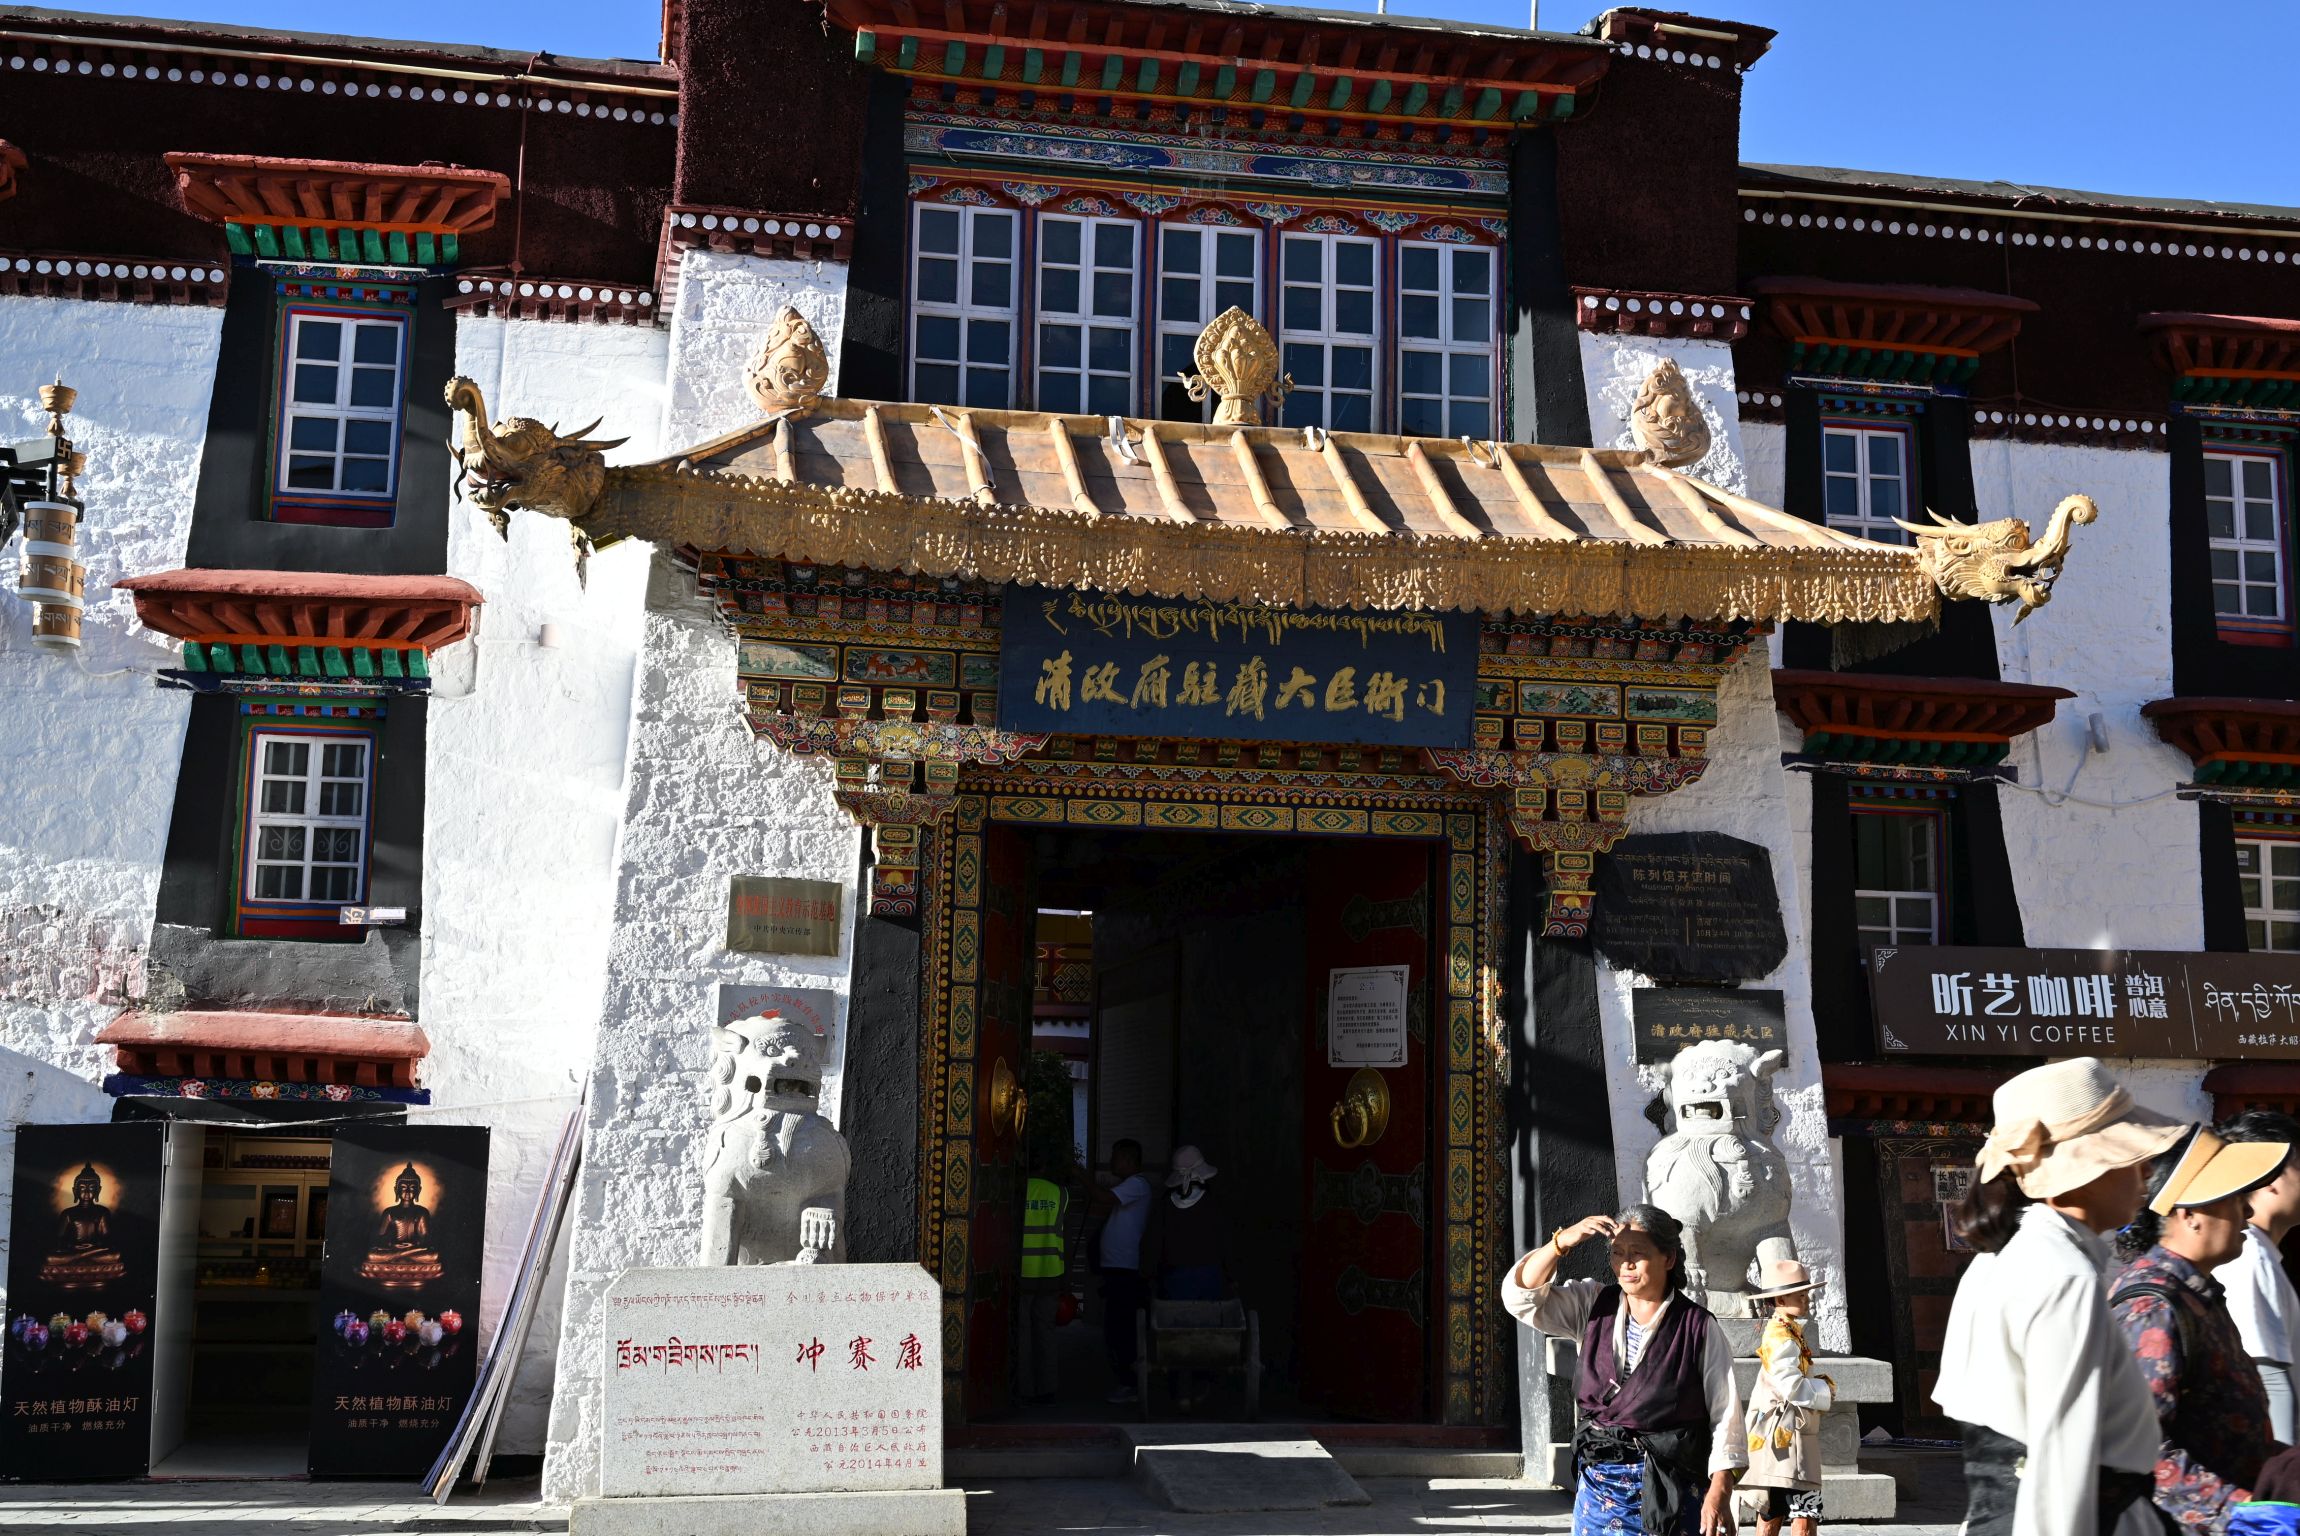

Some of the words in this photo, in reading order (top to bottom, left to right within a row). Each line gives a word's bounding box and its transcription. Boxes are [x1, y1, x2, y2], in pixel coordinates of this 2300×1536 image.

[1632, 868, 1732, 885] 陈列馆开馆时间
[753, 924, 811, 936] 中共中央宣传部
[2124, 973, 2165, 997] 普洱
[1931, 972, 2118, 1019] 昕艺咖啡
[2128, 996, 2169, 1019] 心意
[1946, 1024, 1986, 1041] XIN
[1996, 1025, 2018, 1042] YI
[2029, 1025, 2117, 1043] COFFEE
[2238, 1033, 2300, 1047] 西藏拉萨大昭
[786, 1289, 930, 1304] 全国重点文物保护单位
[796, 1333, 924, 1374] 冲赛康
[13, 1396, 140, 1417] 天然植物酥油灯
[334, 1395, 453, 1412] 天然植物酥油灯
[796, 1408, 929, 1421] 中华人民共和国国务院
[28, 1423, 72, 1433] 油质干净
[82, 1420, 127, 1432] 燃烧充分
[348, 1418, 390, 1429] 油质干净
[397, 1418, 440, 1429] 燃烧充分
[791, 1424, 927, 1438] 公元2013年3月5日公布
[809, 1440, 928, 1453] 西藏自治区人民政府
